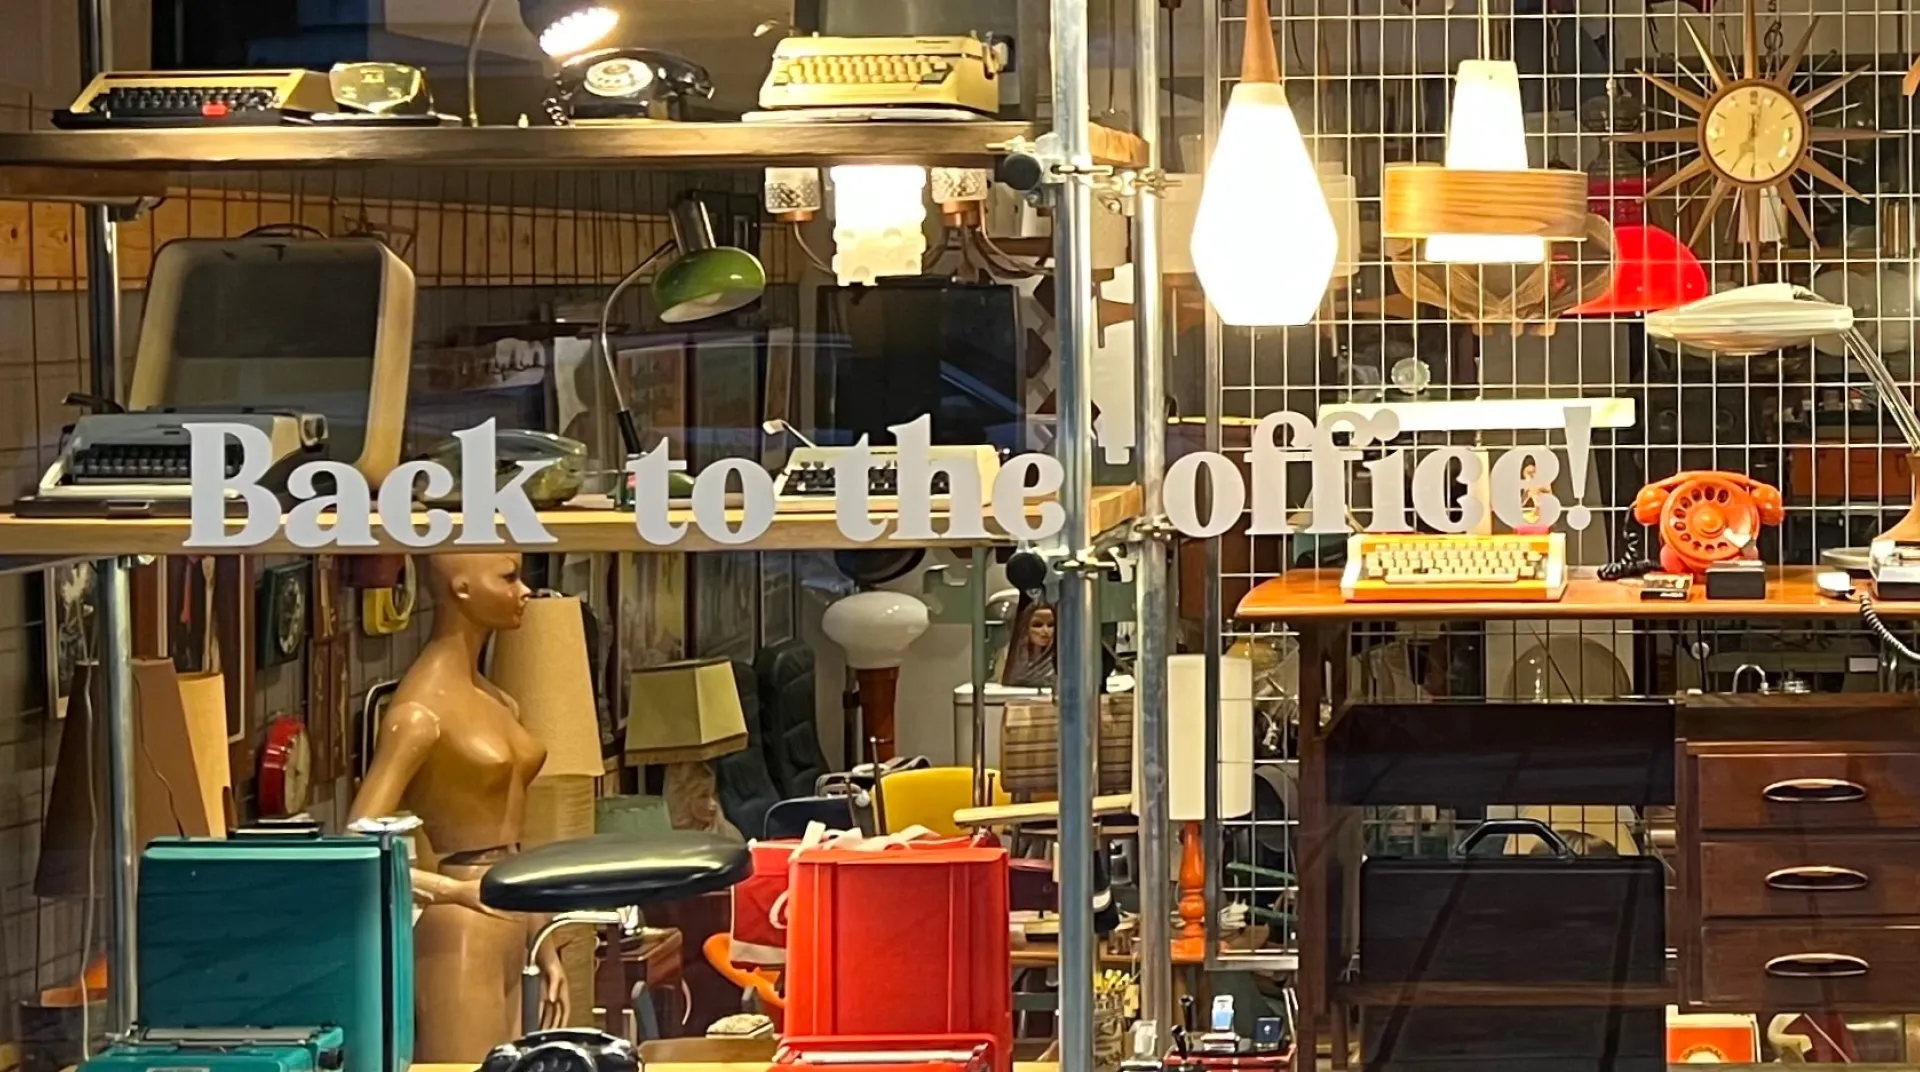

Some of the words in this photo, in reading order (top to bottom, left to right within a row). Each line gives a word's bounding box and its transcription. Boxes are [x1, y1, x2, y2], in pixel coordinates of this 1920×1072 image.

[182, 417, 558, 547] Back
[626, 437, 774, 545] to
[835, 413, 1066, 542] the
[1162, 406, 1592, 538] office!
